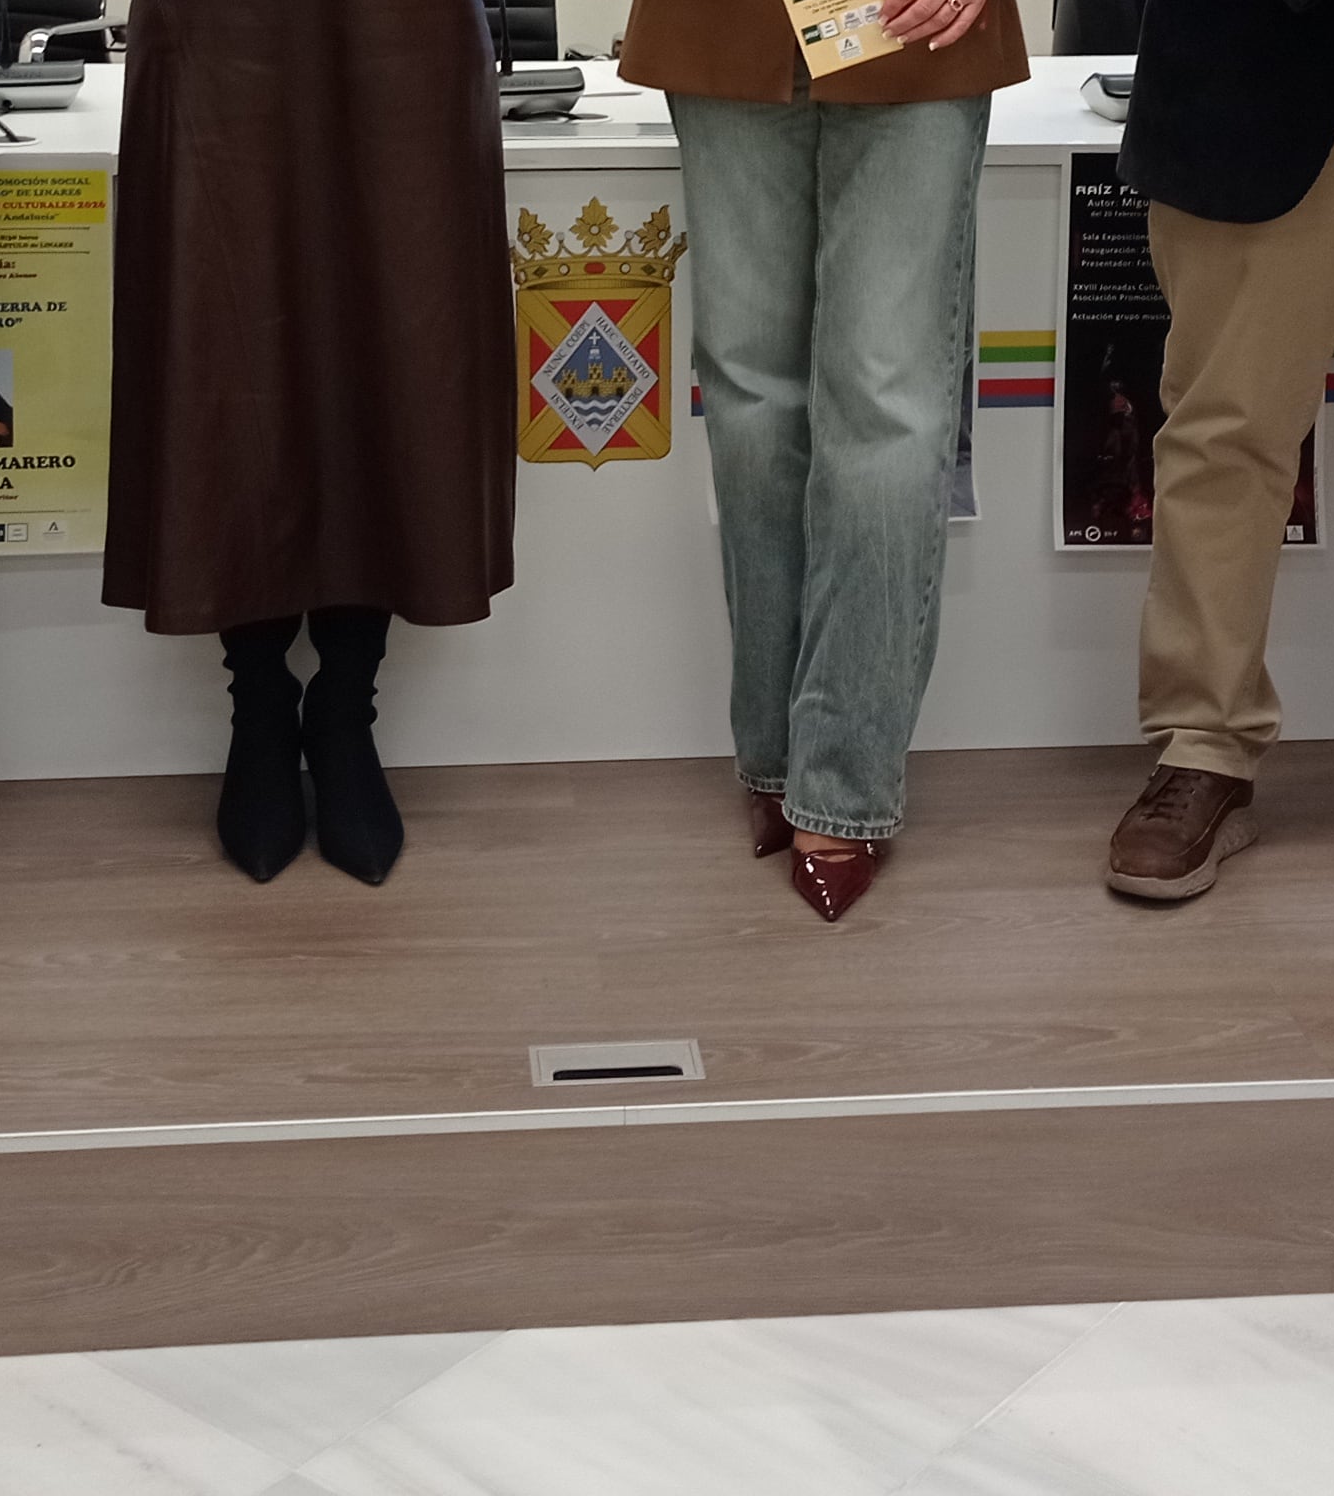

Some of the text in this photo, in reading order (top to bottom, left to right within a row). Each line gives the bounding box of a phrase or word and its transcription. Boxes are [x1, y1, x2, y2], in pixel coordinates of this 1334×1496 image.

[51, 177, 91, 185] SOCIAL
[33, 188, 82, 196] LINARES
[1075, 183, 1112, 196] RAÍZ
[2, 201, 75, 209] CULTURALES
[77, 200, 106, 209] 2026
[1121, 198, 1149, 208] Migu
[1082, 233, 1099, 241] Sala
[1119, 293, 1164, 301] Promoción
[46, 301, 67, 312] DE
[1071, 312, 1113, 320] Actuación
[1115, 313, 1140, 321] grupo
[543, 320, 590, 377] NUNC COEPI
[595, 316, 650, 380] HAEC MUTATIO
